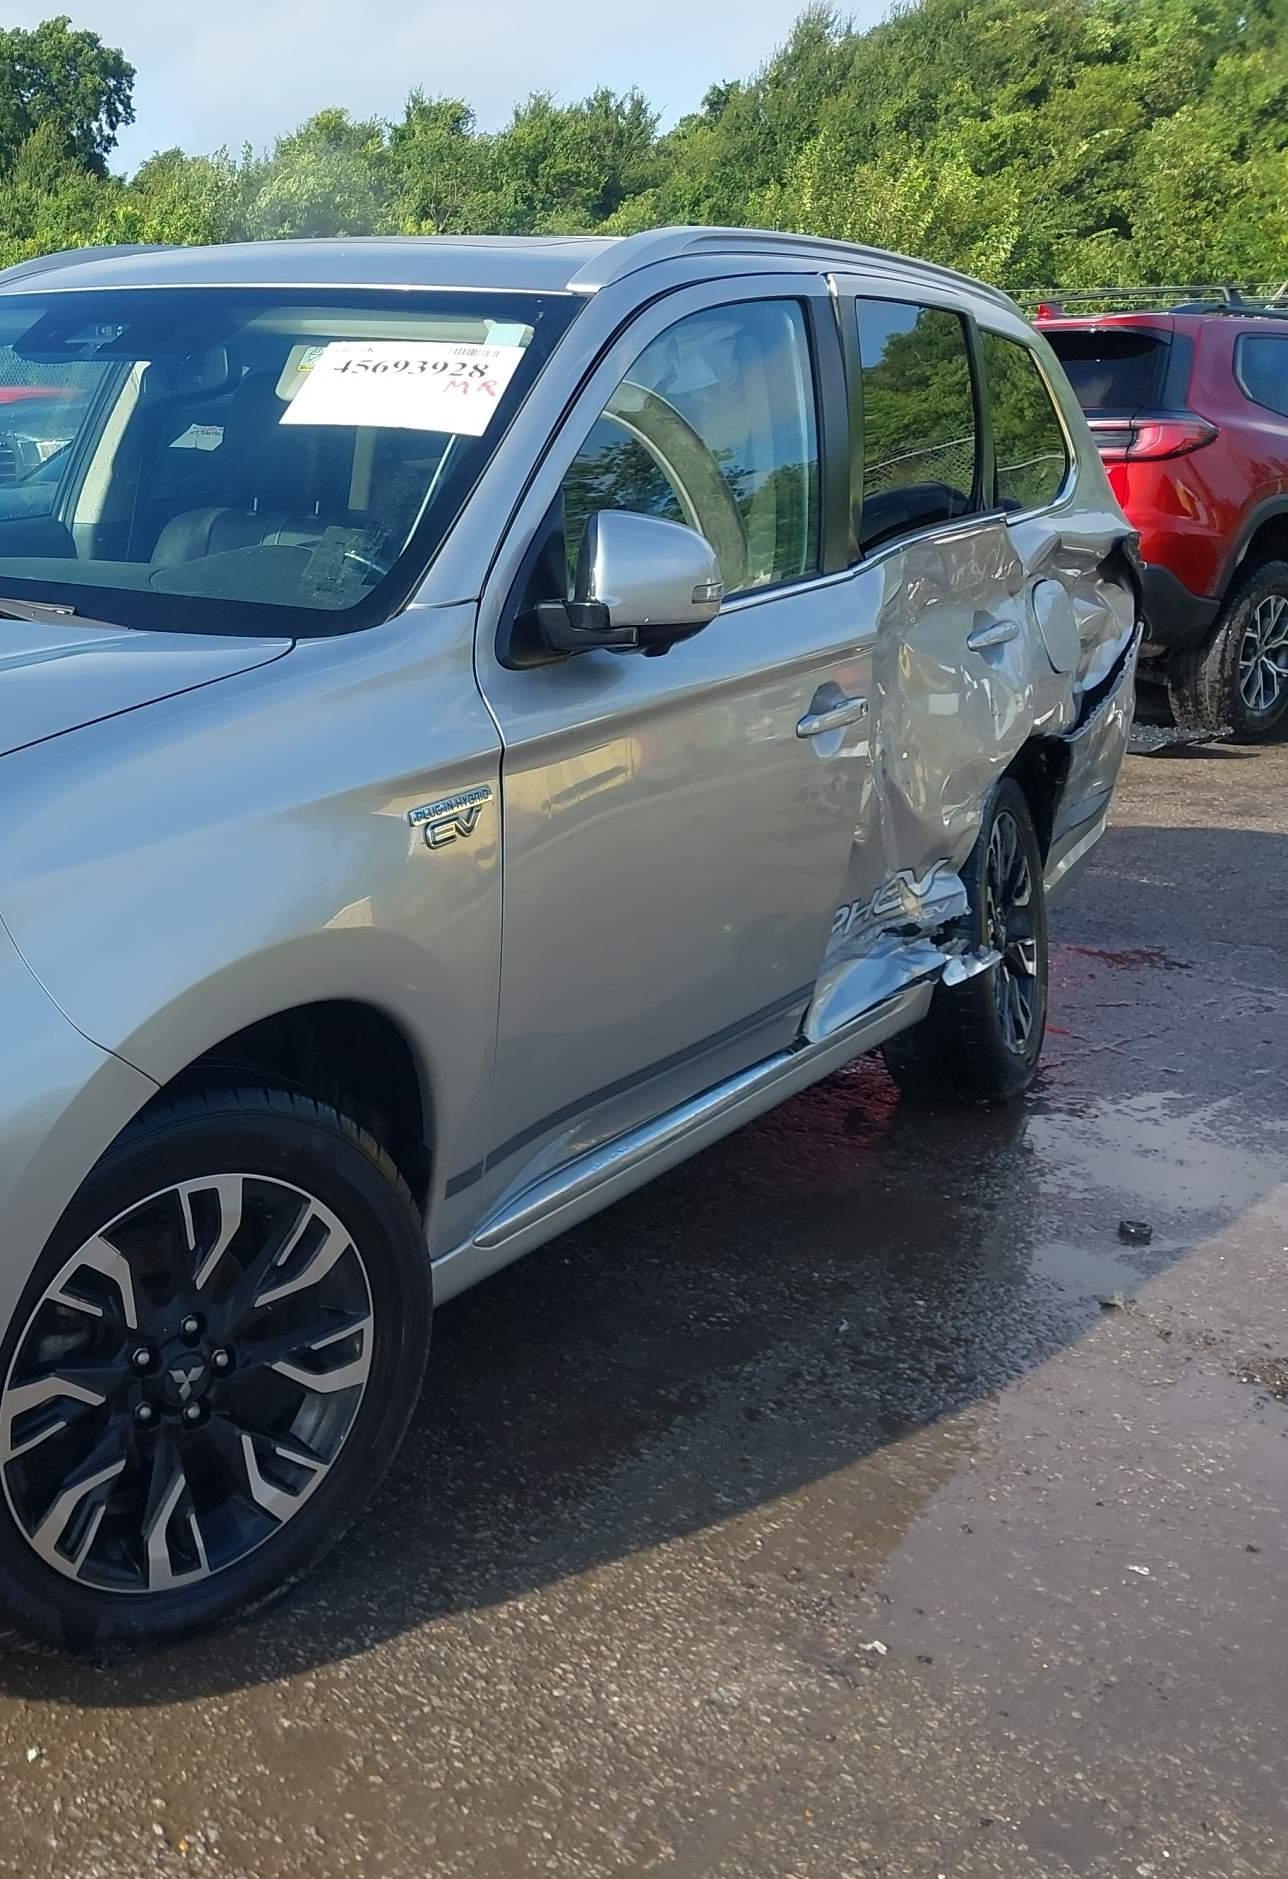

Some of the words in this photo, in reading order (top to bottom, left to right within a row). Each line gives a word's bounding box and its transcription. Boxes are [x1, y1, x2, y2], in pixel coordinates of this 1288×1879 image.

[333, 359, 489, 378] 45693928
[455, 788, 489, 809] HYBRID
[424, 804, 482, 850] EV
